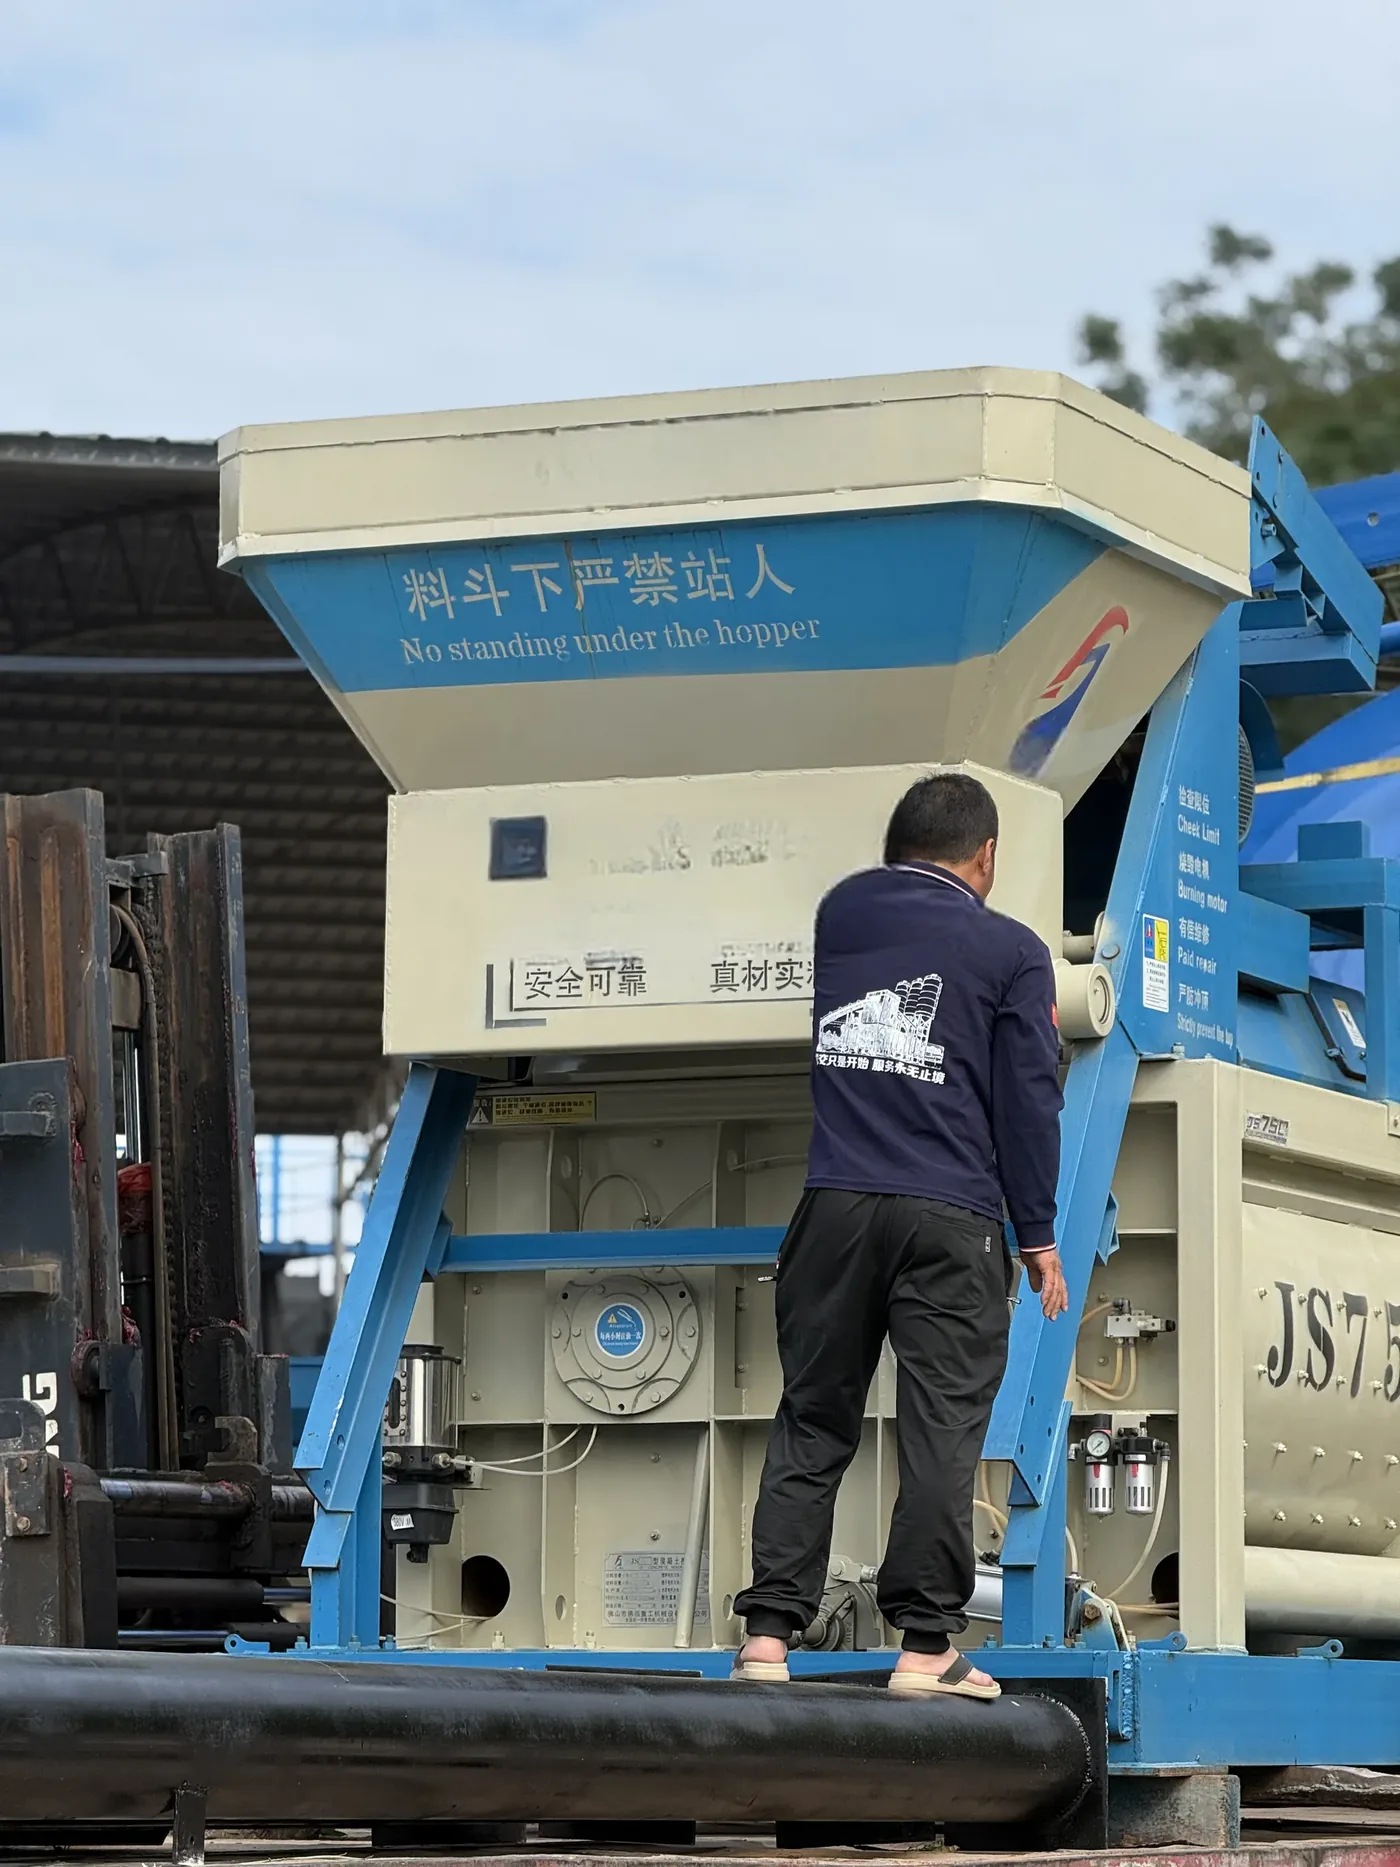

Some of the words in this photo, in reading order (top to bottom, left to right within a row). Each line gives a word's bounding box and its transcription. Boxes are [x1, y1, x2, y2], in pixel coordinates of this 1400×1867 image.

[401, 543, 796, 622] 料斗下严禁站人
[400, 638, 442, 665] No
[449, 632, 569, 662] standing
[573, 624, 657, 654] under
[663, 621, 710, 649] the
[714, 617, 820, 650] hopper
[1177, 878, 1205, 908] Burning
[1207, 893, 1228, 914] motor
[1177, 945, 1194, 967] Paid
[1196, 955, 1217, 975] repair
[524, 959, 647, 1000] 安全可靠
[872, 1059, 946, 1085] 服务永无止境
